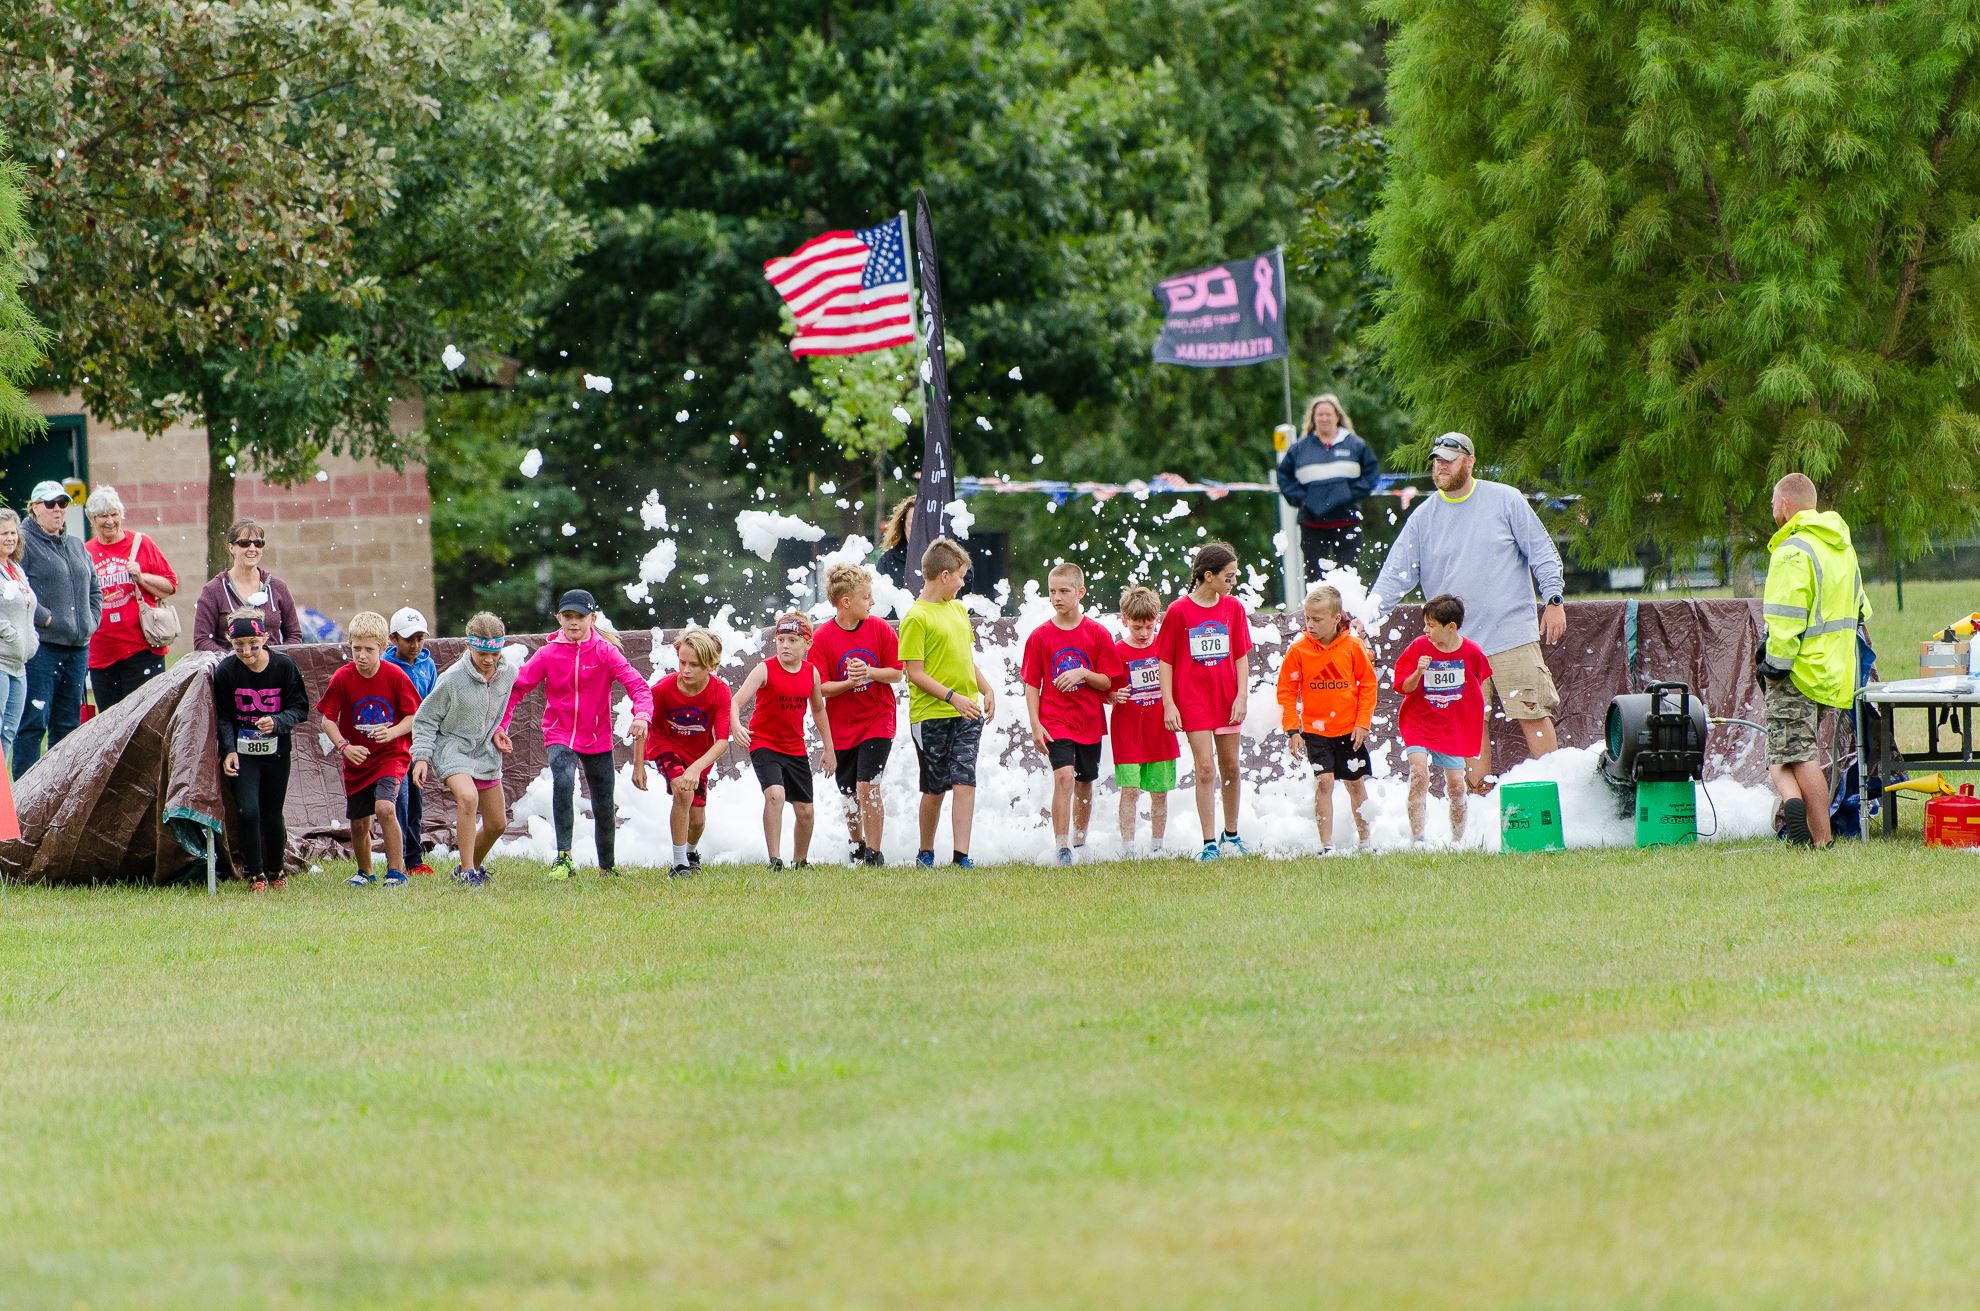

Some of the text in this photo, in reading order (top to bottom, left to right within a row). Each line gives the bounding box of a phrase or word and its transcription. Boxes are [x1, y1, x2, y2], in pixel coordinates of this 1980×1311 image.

[1201, 638, 1221, 651] 876
[1141, 670, 1160, 683] 903
[1434, 673, 1455, 684] 840
[1310, 680, 1349, 690] adidas
[234, 688, 282, 712] DG
[247, 742, 269, 752] 805
